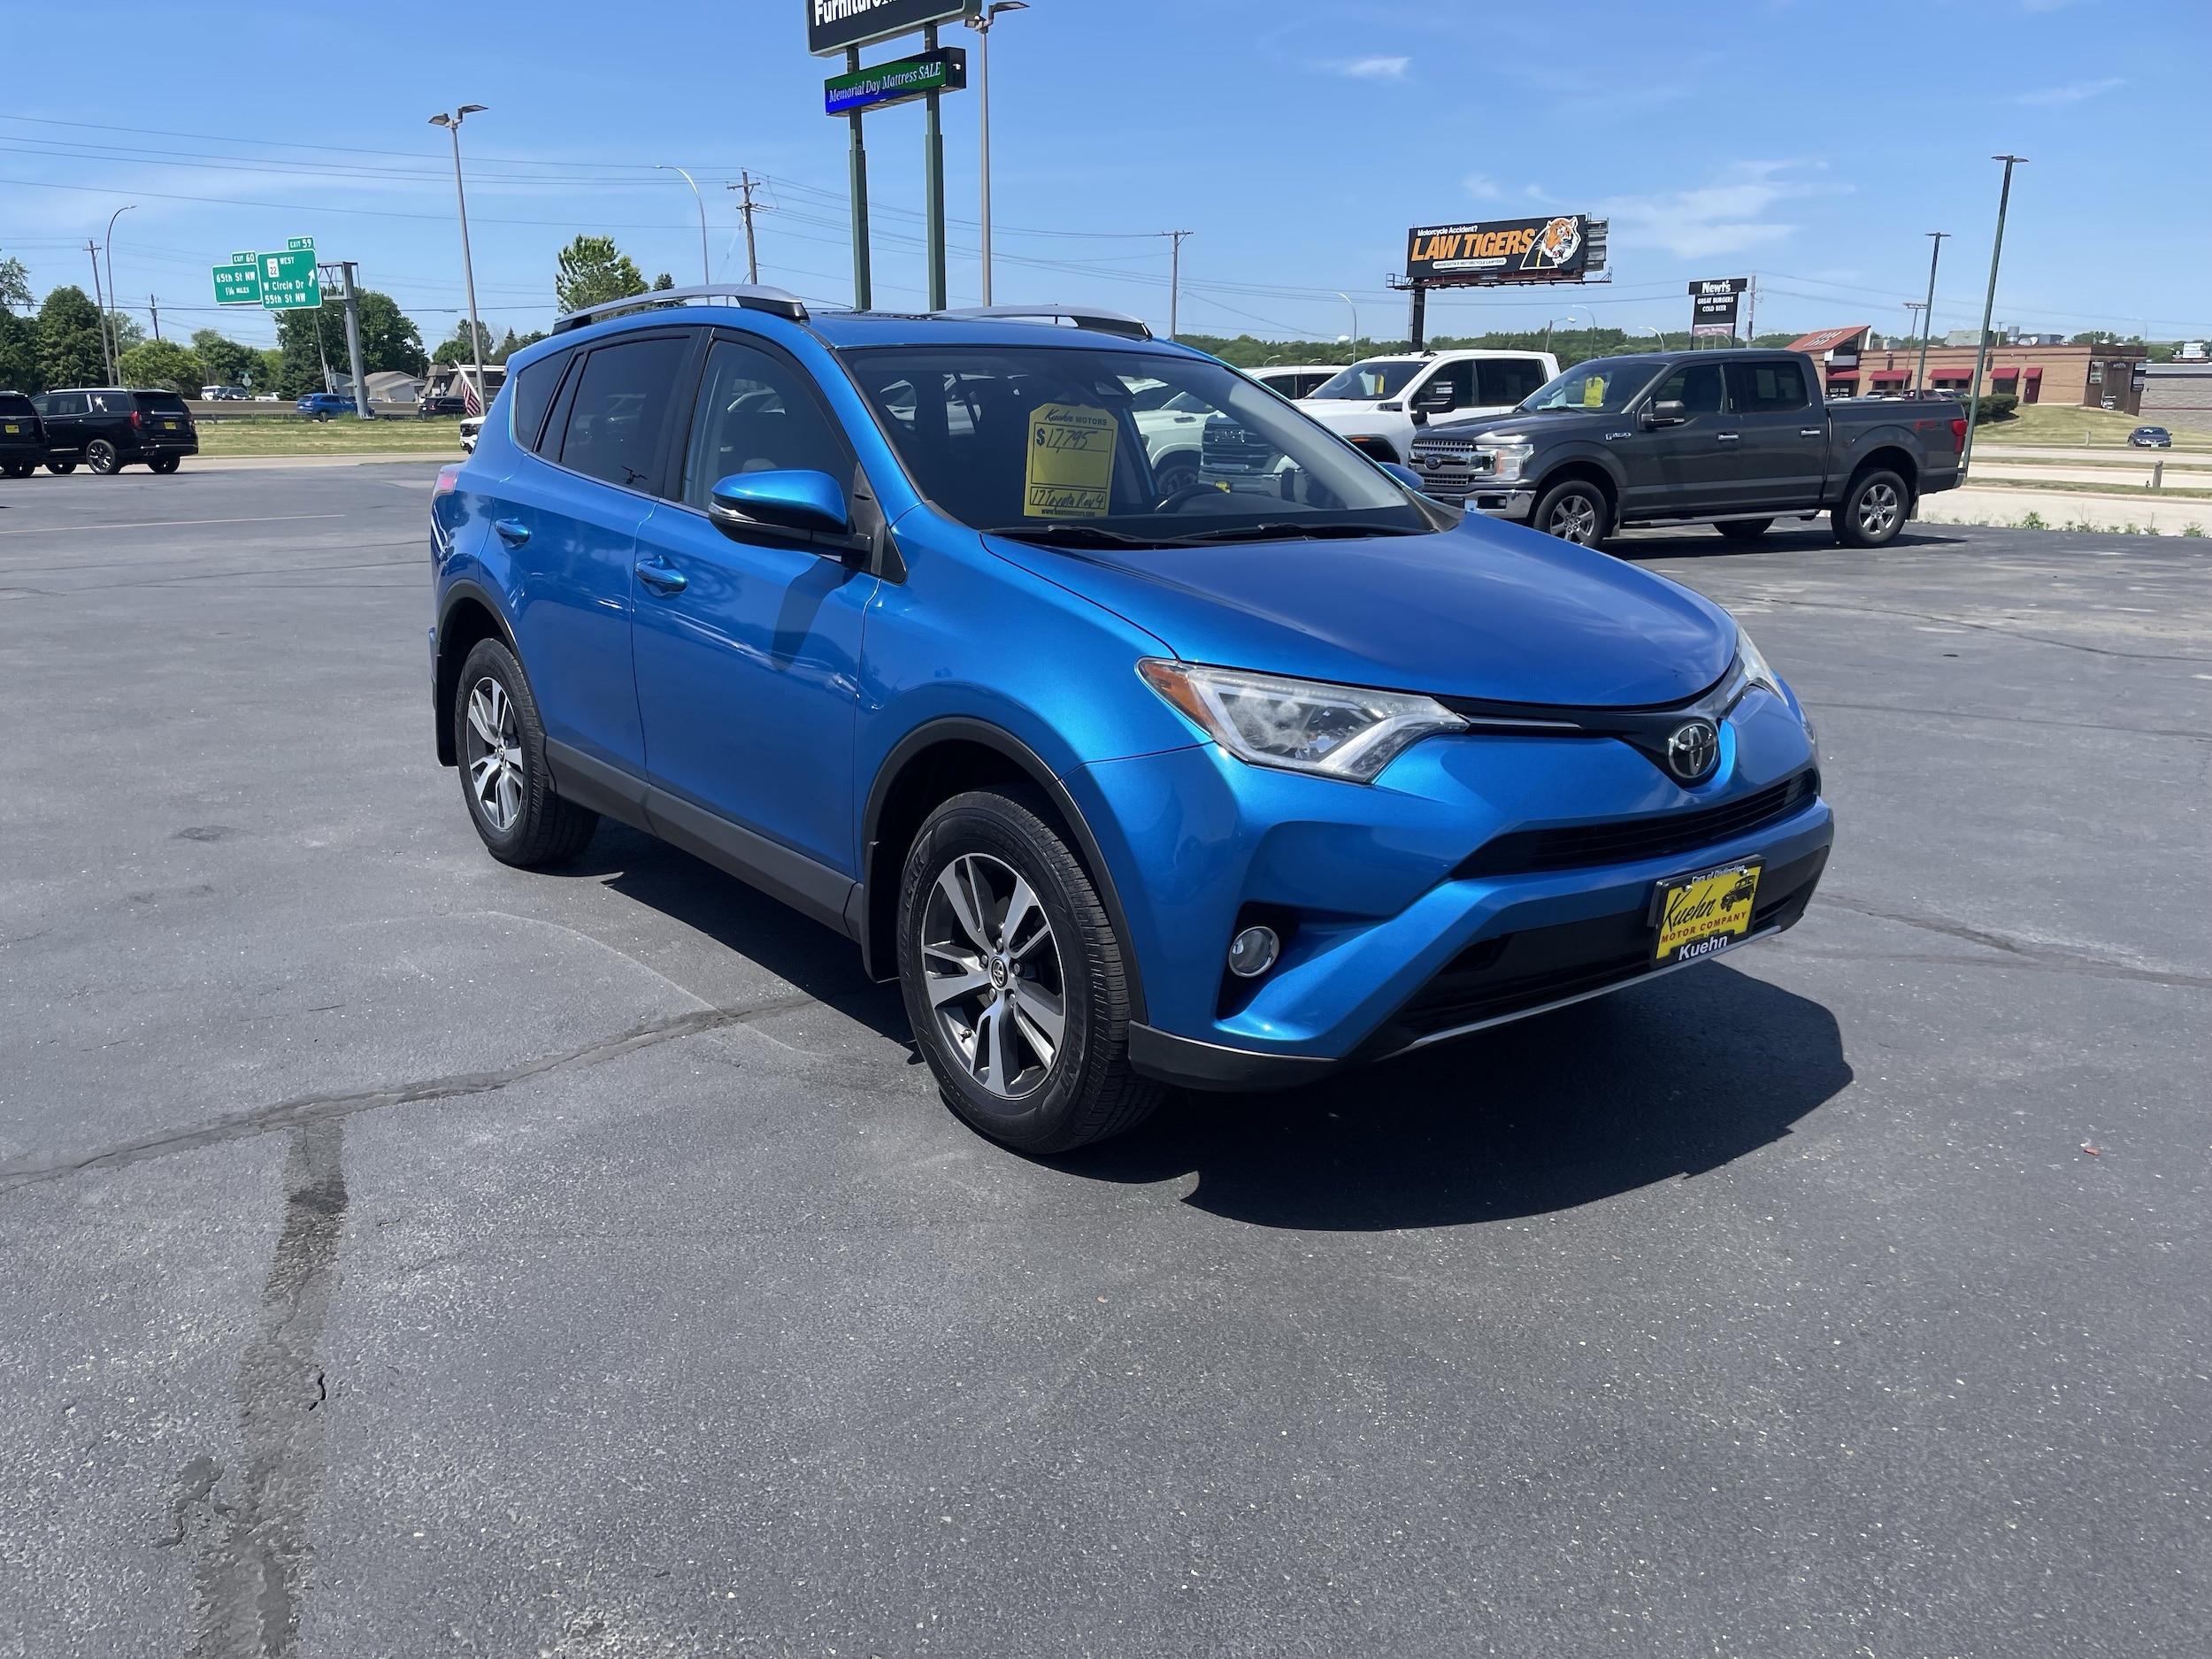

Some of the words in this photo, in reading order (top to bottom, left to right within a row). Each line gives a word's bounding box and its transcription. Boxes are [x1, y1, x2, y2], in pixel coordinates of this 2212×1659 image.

[828, 81, 864, 103] Memorial
[865, 80, 881, 96] Day
[882, 70, 918, 89] Mattress
[918, 61, 941, 78] SALE
[302, 238, 312, 248] 59
[1411, 234, 1461, 262] LAW
[1463, 228, 1536, 257] TIGERS
[245, 253, 255, 263] 60
[270, 266, 277, 275] 22
[216, 273, 233, 283] 65th
[234, 273, 243, 282] St
[245, 271, 256, 281] NW
[263, 282, 269, 291] W
[272, 280, 293, 290] Circle
[296, 280, 304, 289] Dr
[1702, 280, 1731, 293] Newt's
[265, 295, 282, 304] 55th
[284, 294, 293, 303] St
[295, 293, 306, 303] NW
[1075, 416, 1107, 426] MOTORS
[1661, 926, 1696, 944] MOTOR
[1700, 911, 1747, 931] COMPANY
[1678, 935, 1728, 961] Kuehn
